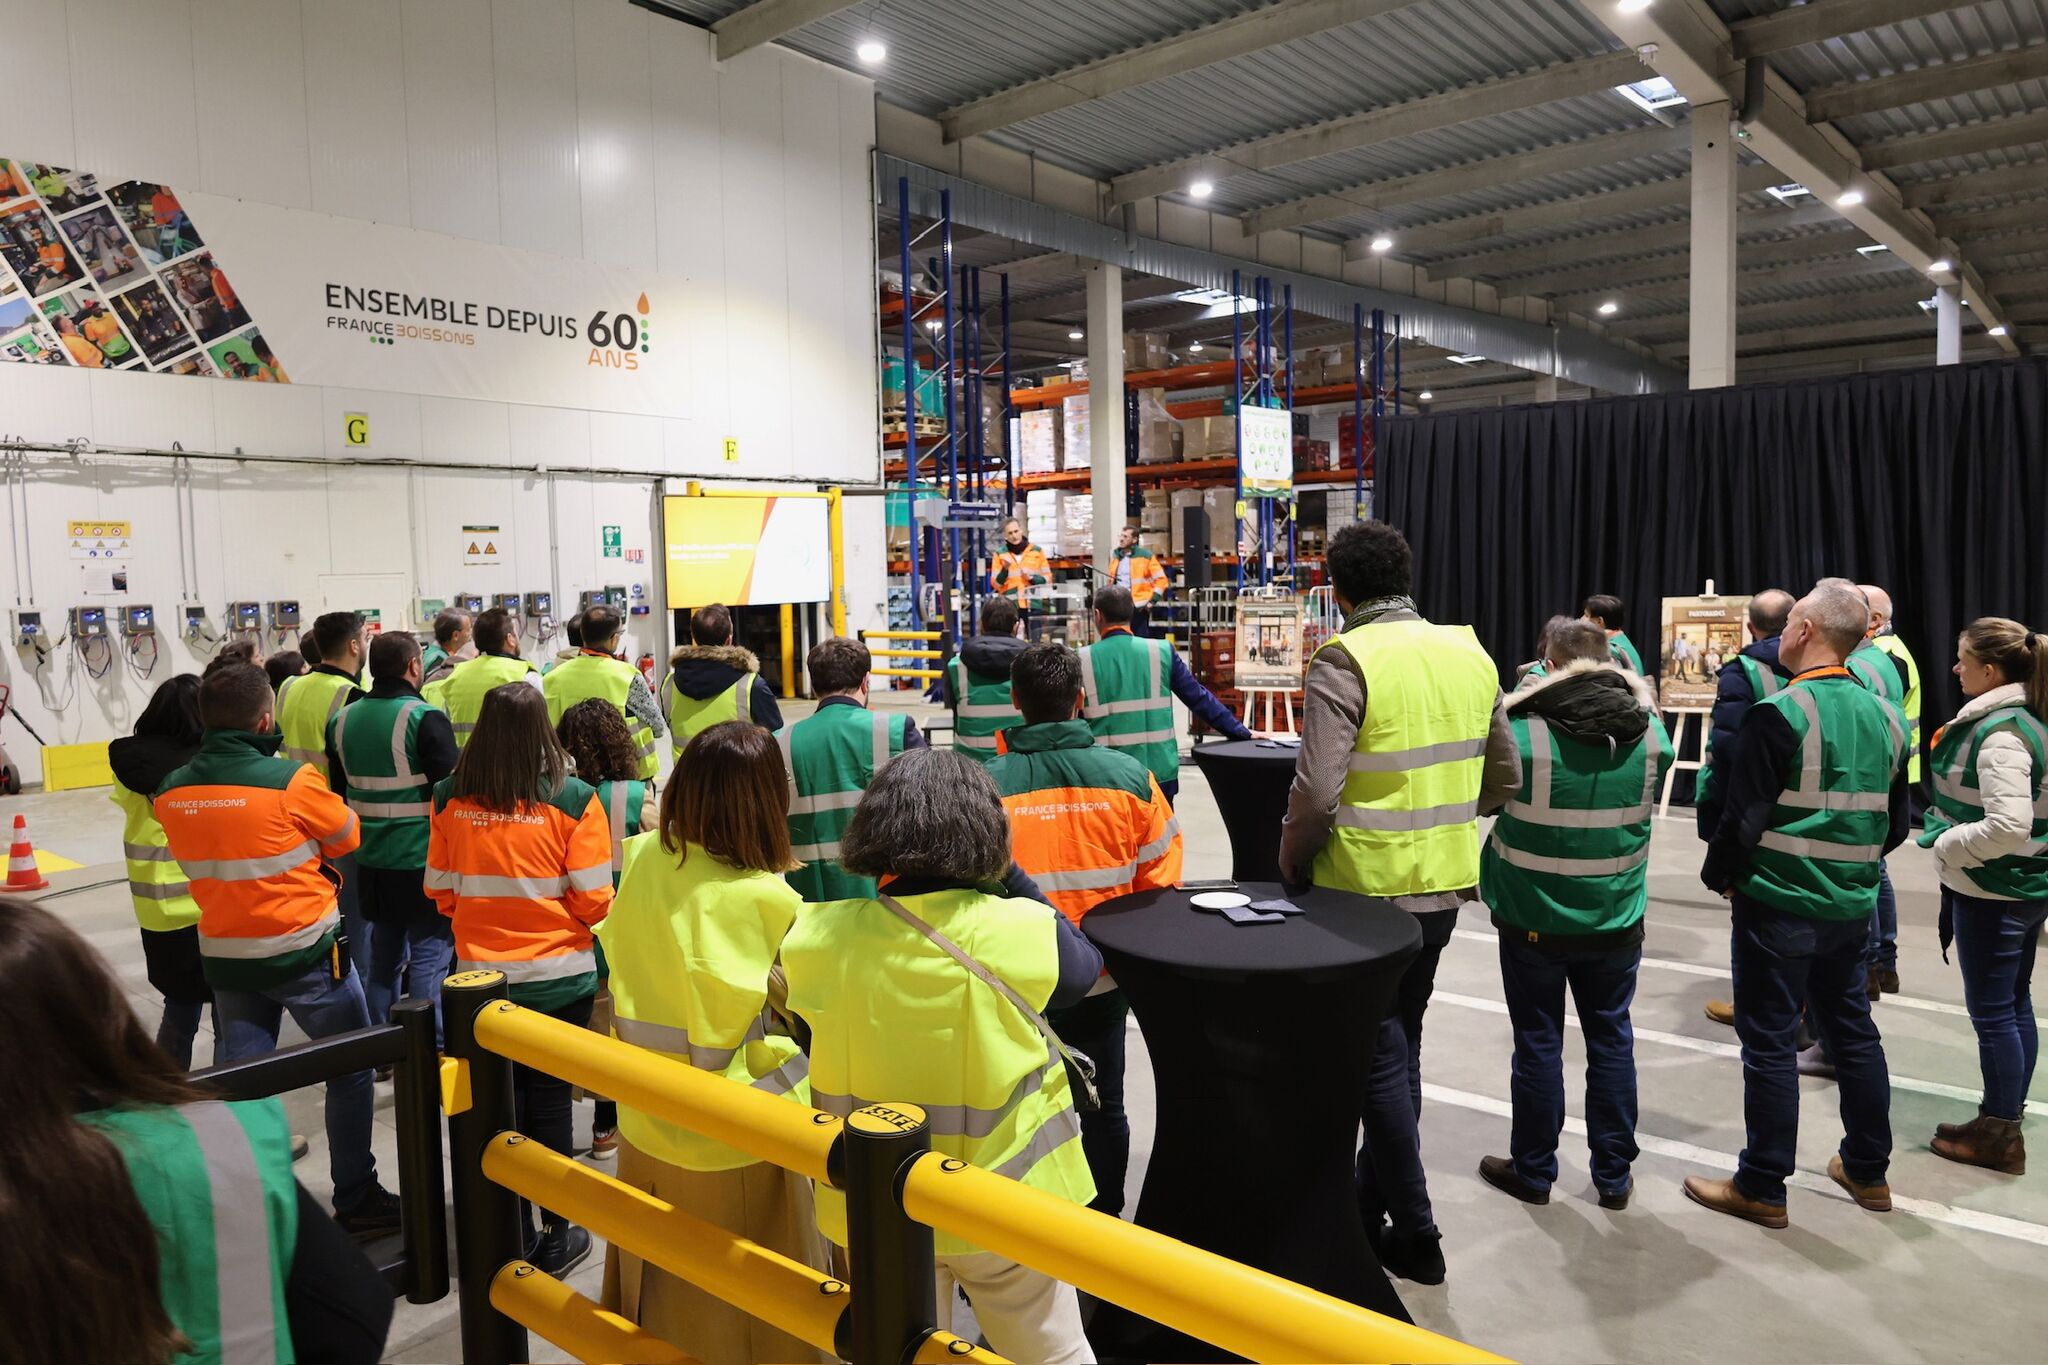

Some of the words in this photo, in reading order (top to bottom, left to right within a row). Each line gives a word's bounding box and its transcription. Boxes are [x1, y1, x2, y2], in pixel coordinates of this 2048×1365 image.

[326, 283, 478, 326] ENSEMBLE
[487, 306, 577, 339] DEPUIS
[587, 310, 637, 351] 60
[588, 348, 638, 370] ANS
[348, 419, 366, 444] G
[726, 441, 736, 460] F
